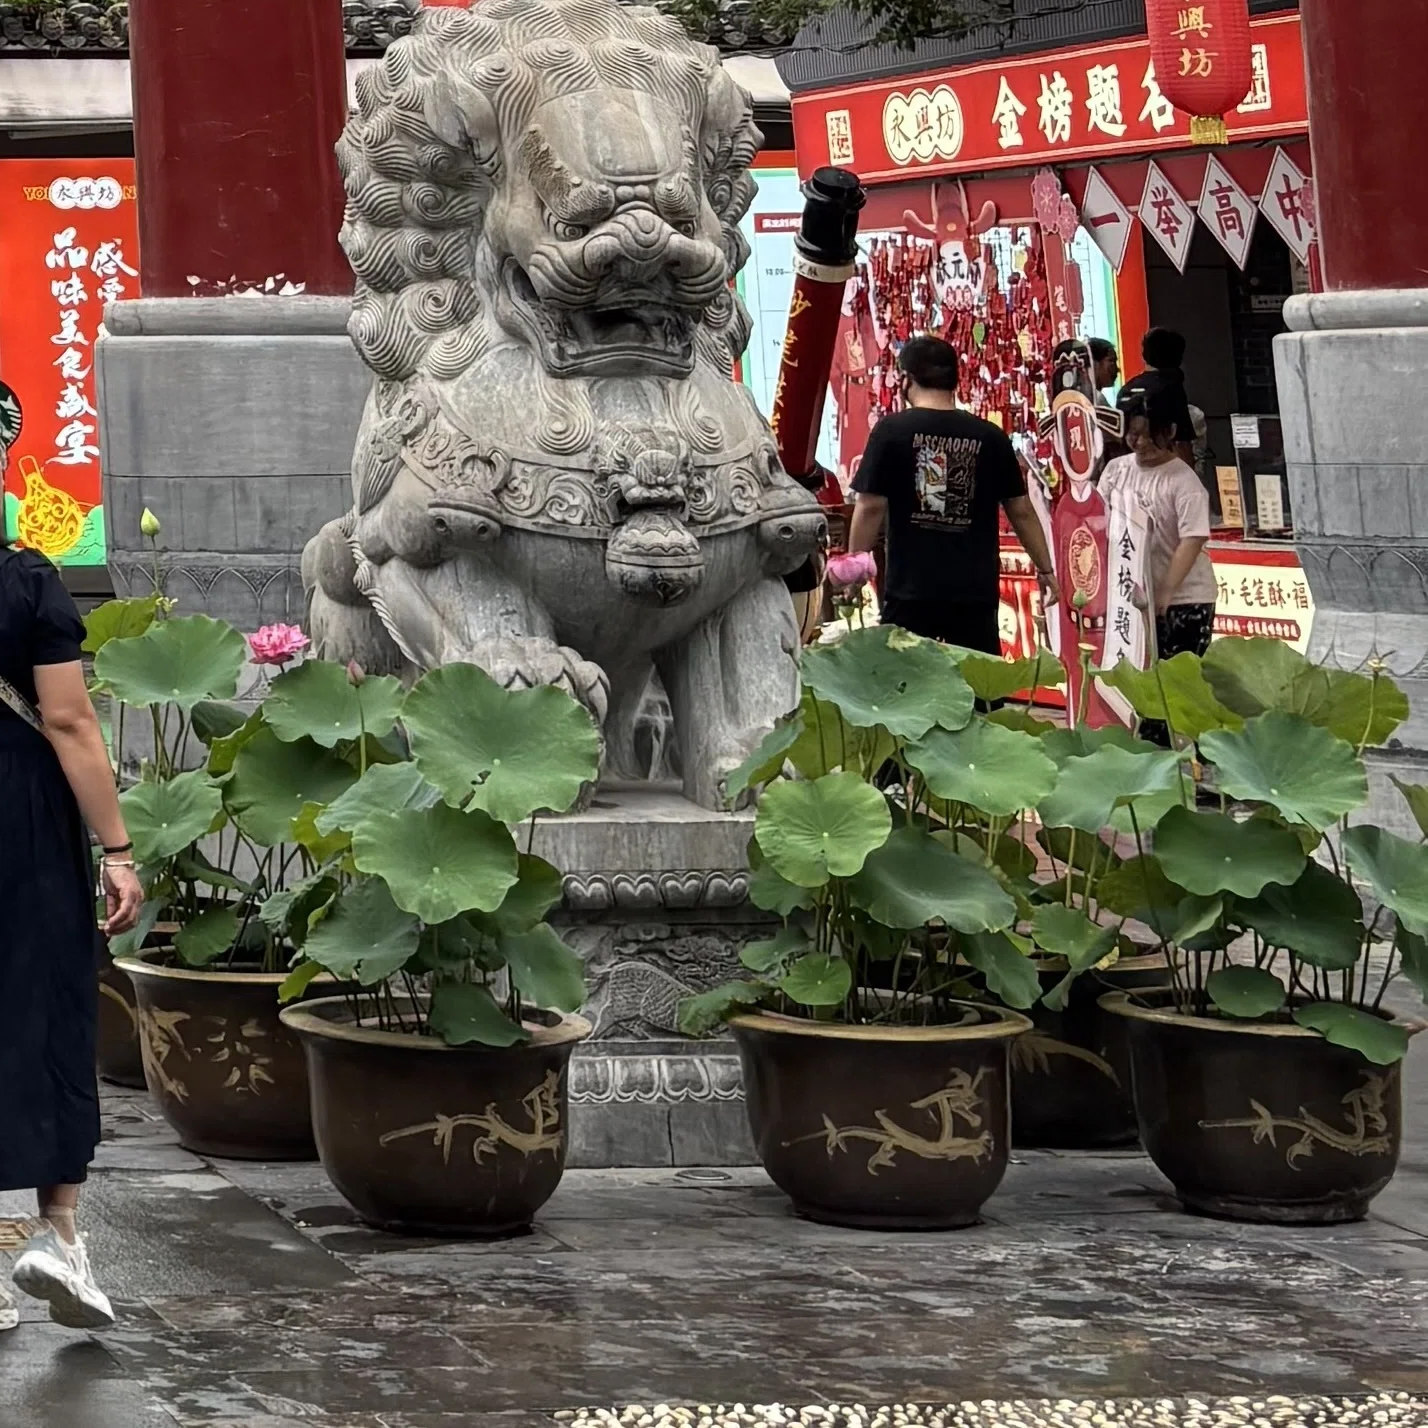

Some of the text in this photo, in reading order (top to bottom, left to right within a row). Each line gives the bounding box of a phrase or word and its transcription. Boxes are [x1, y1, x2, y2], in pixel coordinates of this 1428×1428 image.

[889, 97, 956, 147] 永興坊
[992, 63, 1175, 149] 金榜题名
